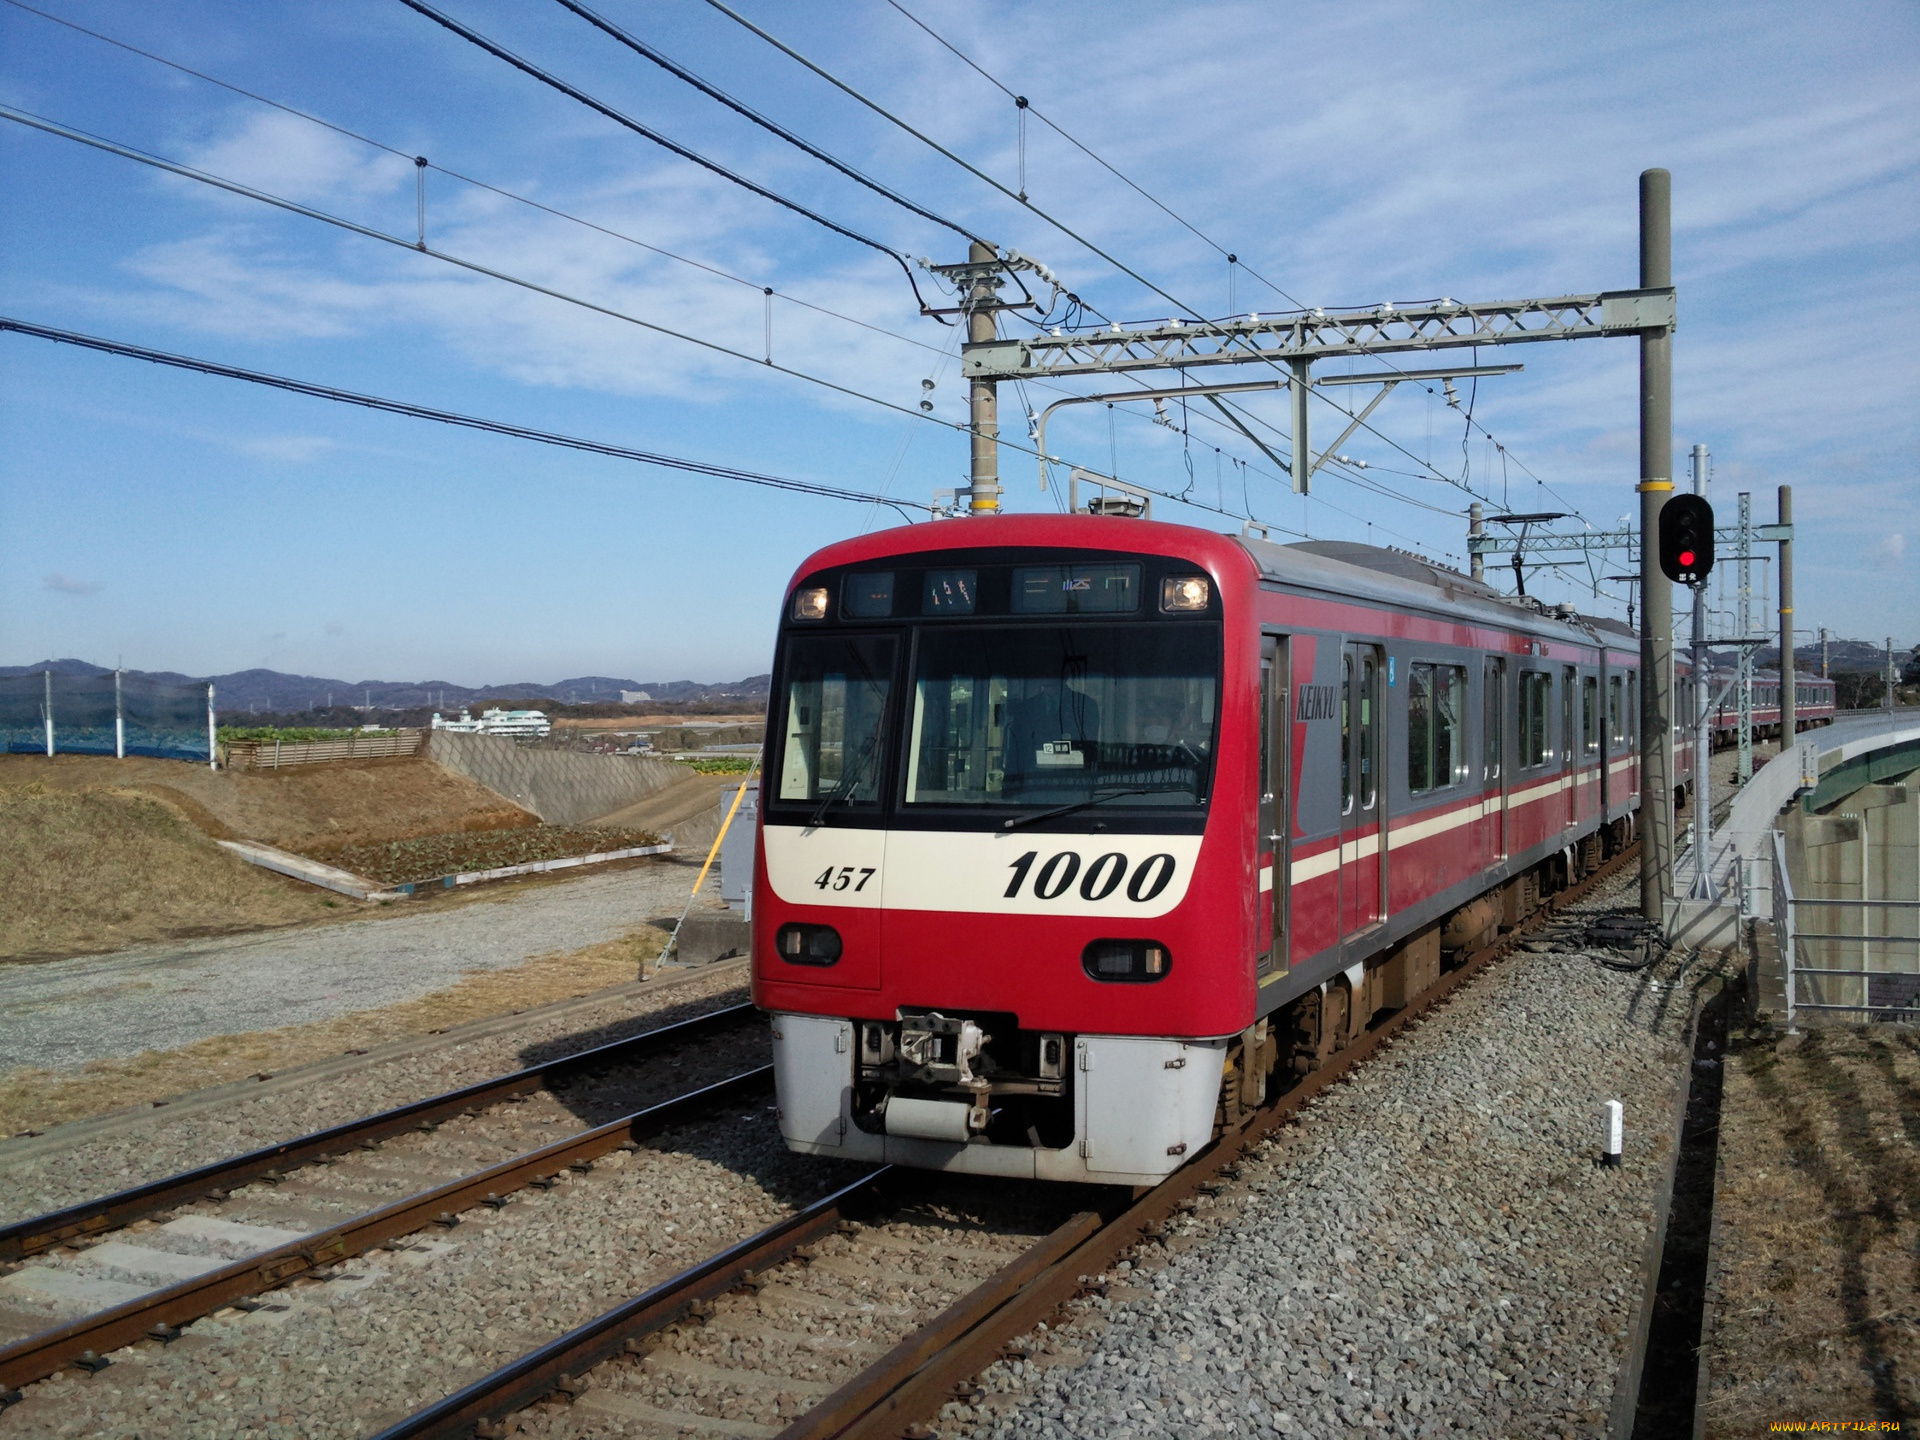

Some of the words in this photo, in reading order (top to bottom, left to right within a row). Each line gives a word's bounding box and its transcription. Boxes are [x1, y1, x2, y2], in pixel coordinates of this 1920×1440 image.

[1297, 685, 1337, 720] KEIKYU
[813, 866, 876, 892] 457
[1002, 851, 1177, 903] 1000
